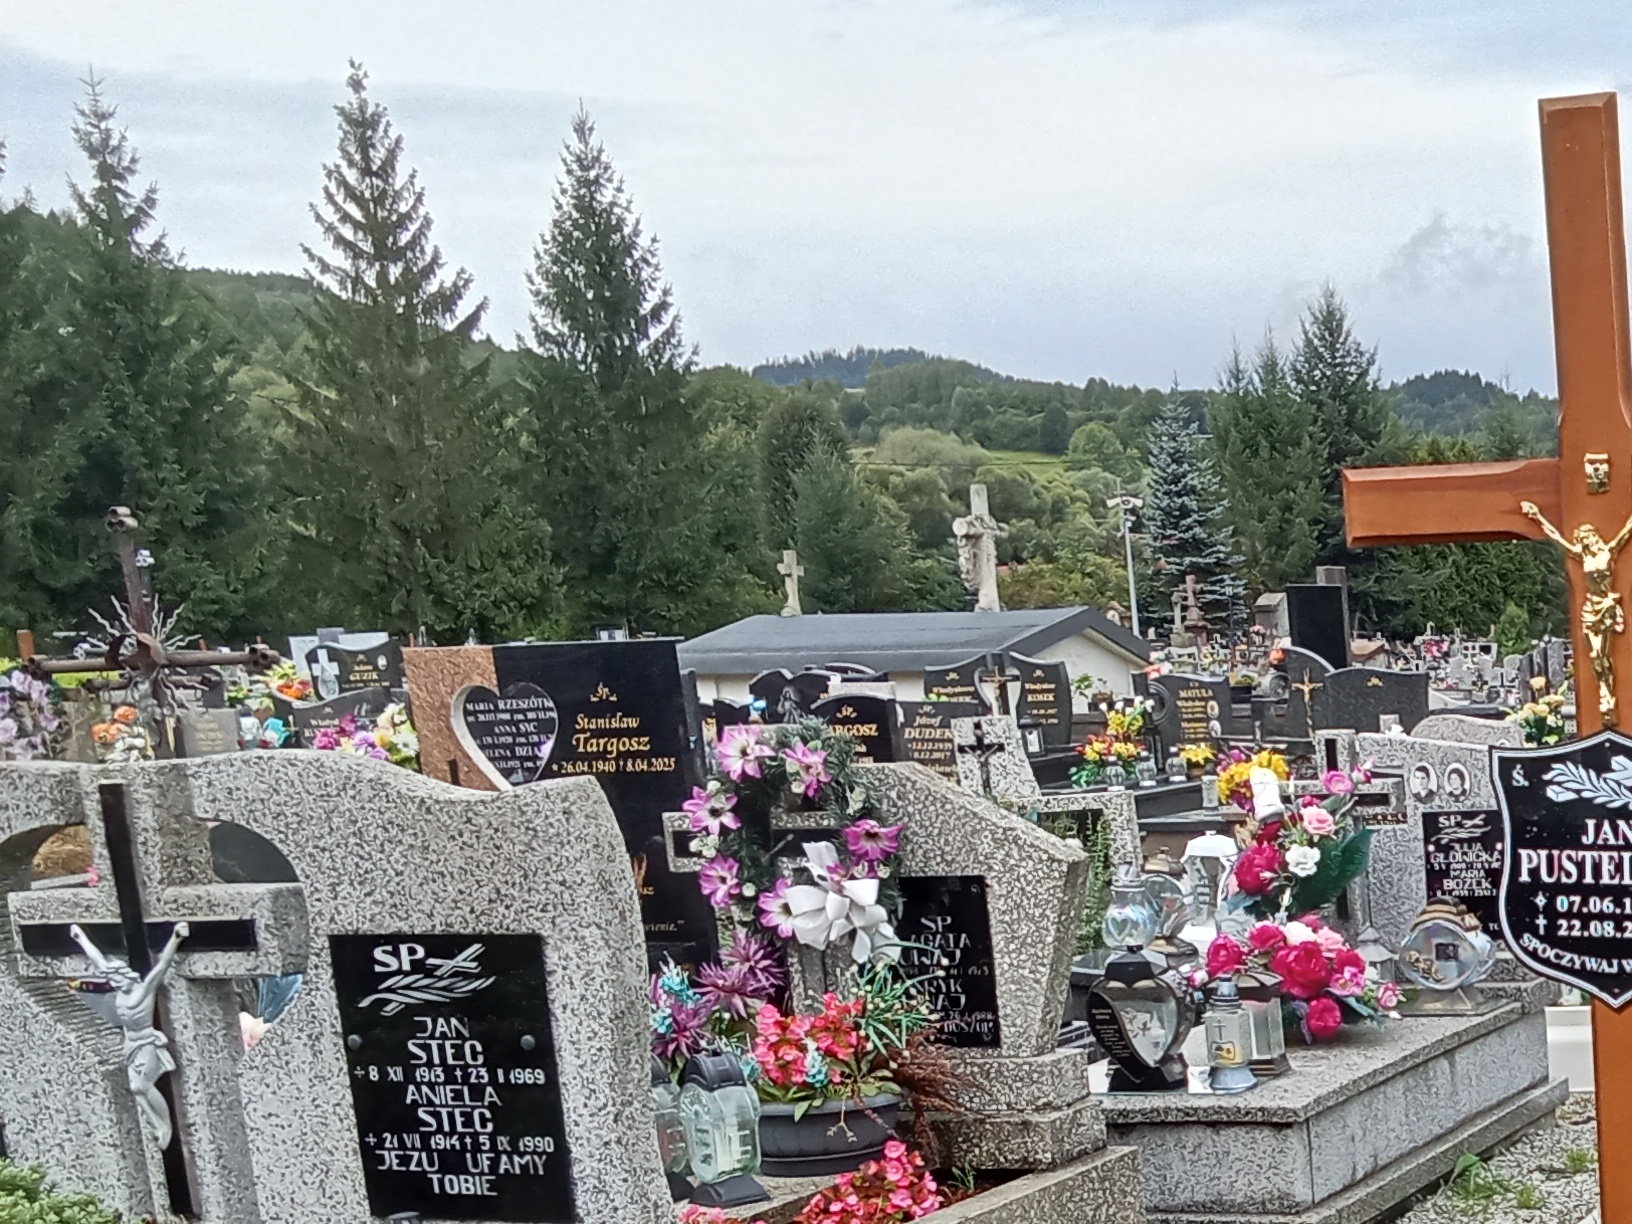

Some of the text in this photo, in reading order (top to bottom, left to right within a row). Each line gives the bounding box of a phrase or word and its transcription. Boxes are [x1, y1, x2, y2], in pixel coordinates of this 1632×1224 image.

[572, 732, 651, 758] Targosz
[560, 759, 616, 774] 26.04.1940
[1450, 869, 1486, 879] MARIA
[920, 915, 952, 933] SP
[910, 933, 972, 948] AGATA
[373, 943, 426, 972] SP
[1519, 932, 1618, 974] SPOCZYWAJ
[413, 1016, 470, 1038] JAN
[407, 1039, 484, 1065] STEC
[368, 1065, 379, 1082] 8
[387, 1066, 404, 1082] XII
[415, 1067, 445, 1083] 1913
[467, 1067, 489, 1083] 23
[509, 1068, 546, 1084] 1969
[405, 1085, 503, 1106] ANIELA
[417, 1107, 494, 1133] STEC
[382, 1132, 555, 1153] 21 VII 1914 5 IX 1990
[375, 1150, 440, 1172] JEZU
[427, 1173, 498, 1196] TOBIE
